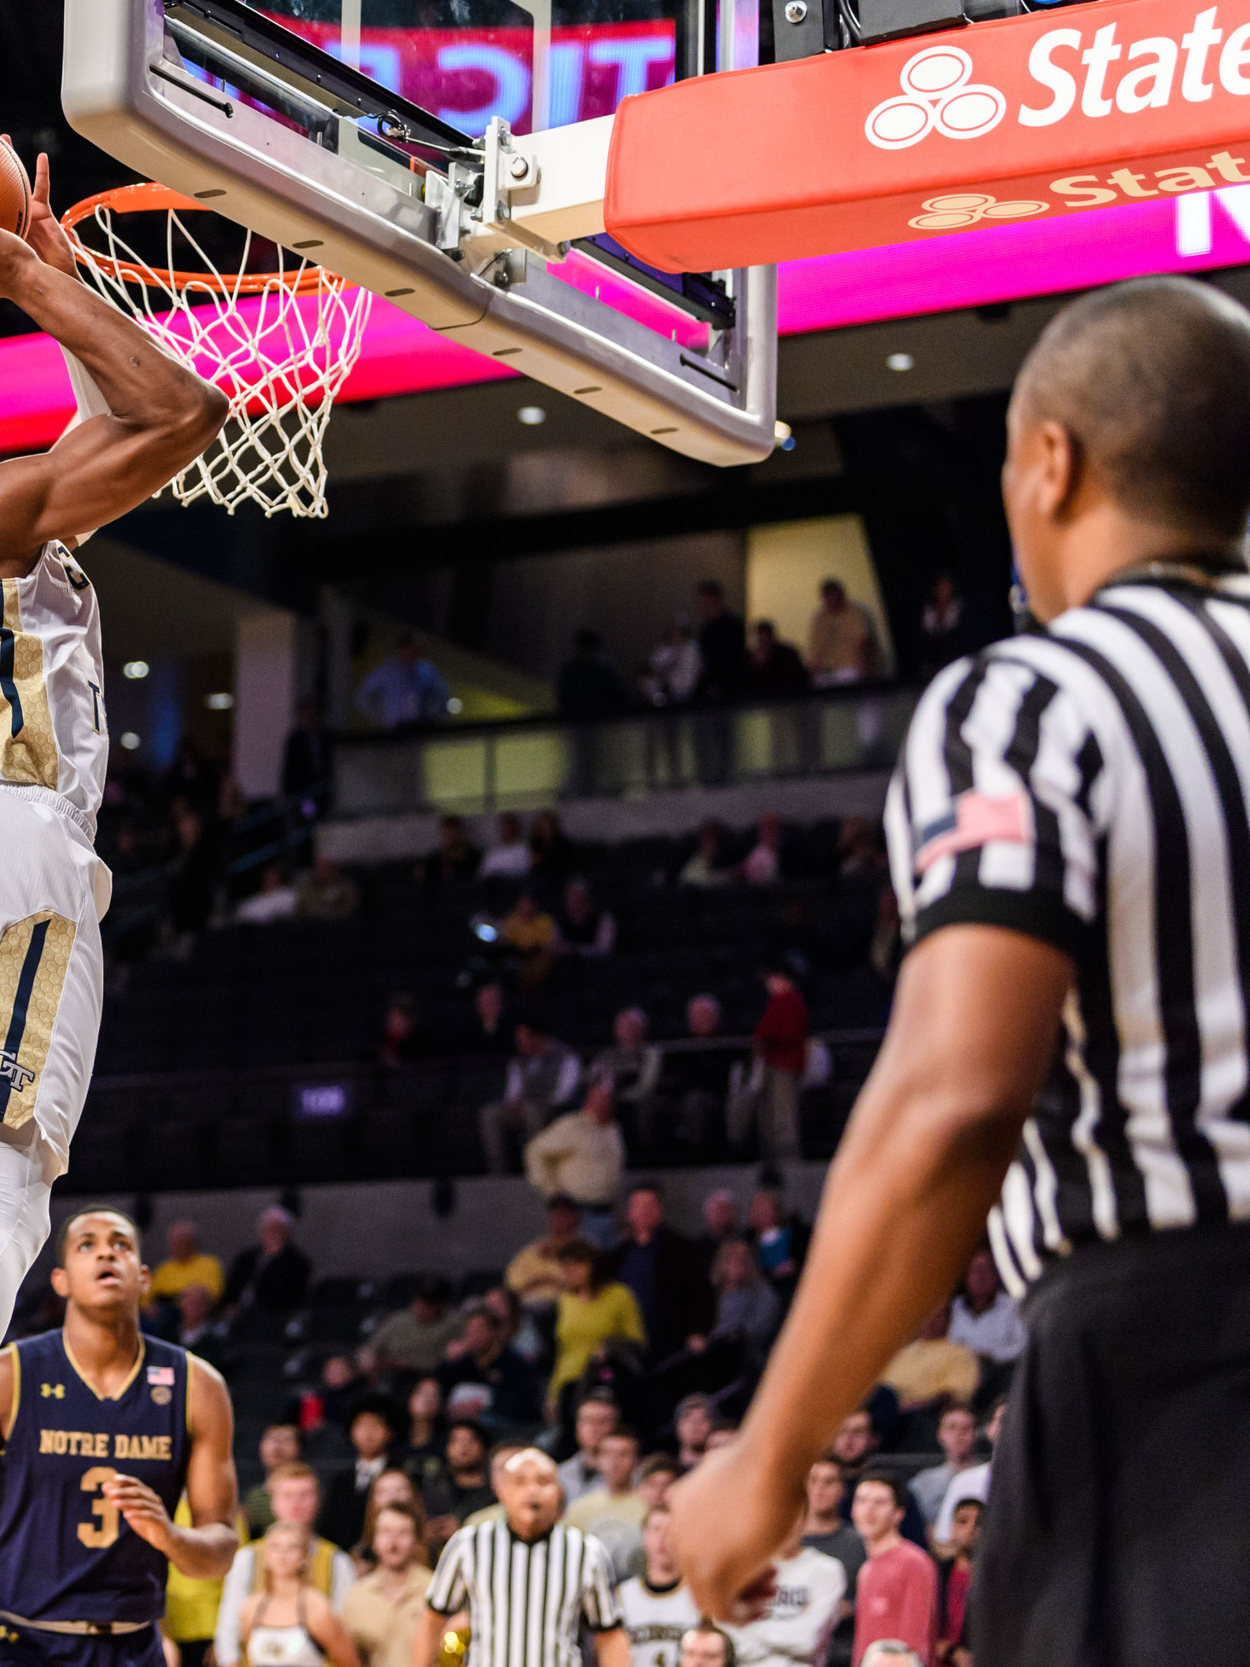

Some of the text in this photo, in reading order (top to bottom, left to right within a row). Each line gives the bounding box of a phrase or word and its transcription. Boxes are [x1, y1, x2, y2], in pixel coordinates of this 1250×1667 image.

[1018, 6, 1250, 127] State
[39, 1429, 173, 1461] NOTRE DAME
[76, 1466, 121, 1549] 3
